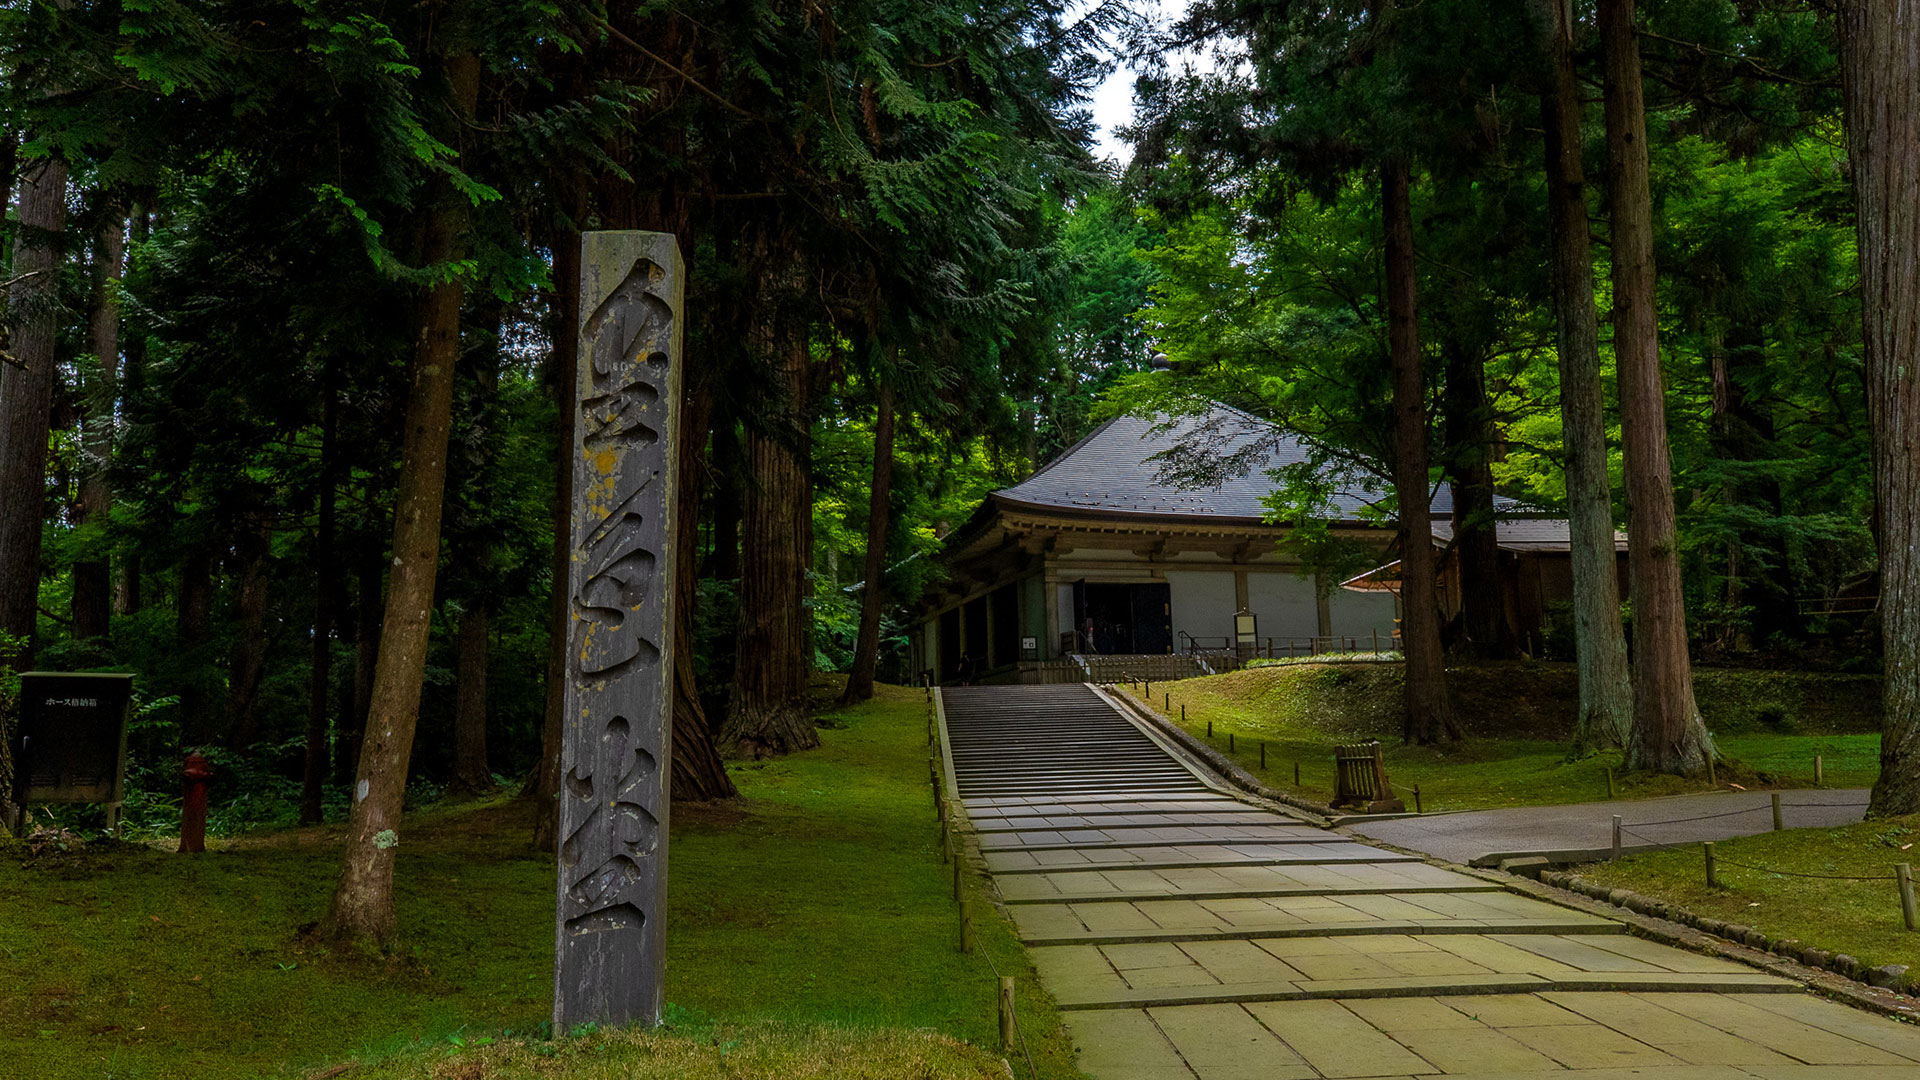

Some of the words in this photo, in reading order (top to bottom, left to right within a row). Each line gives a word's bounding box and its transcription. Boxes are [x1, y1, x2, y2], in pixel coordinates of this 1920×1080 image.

[45, 697, 97, 707] ホース格納箱
